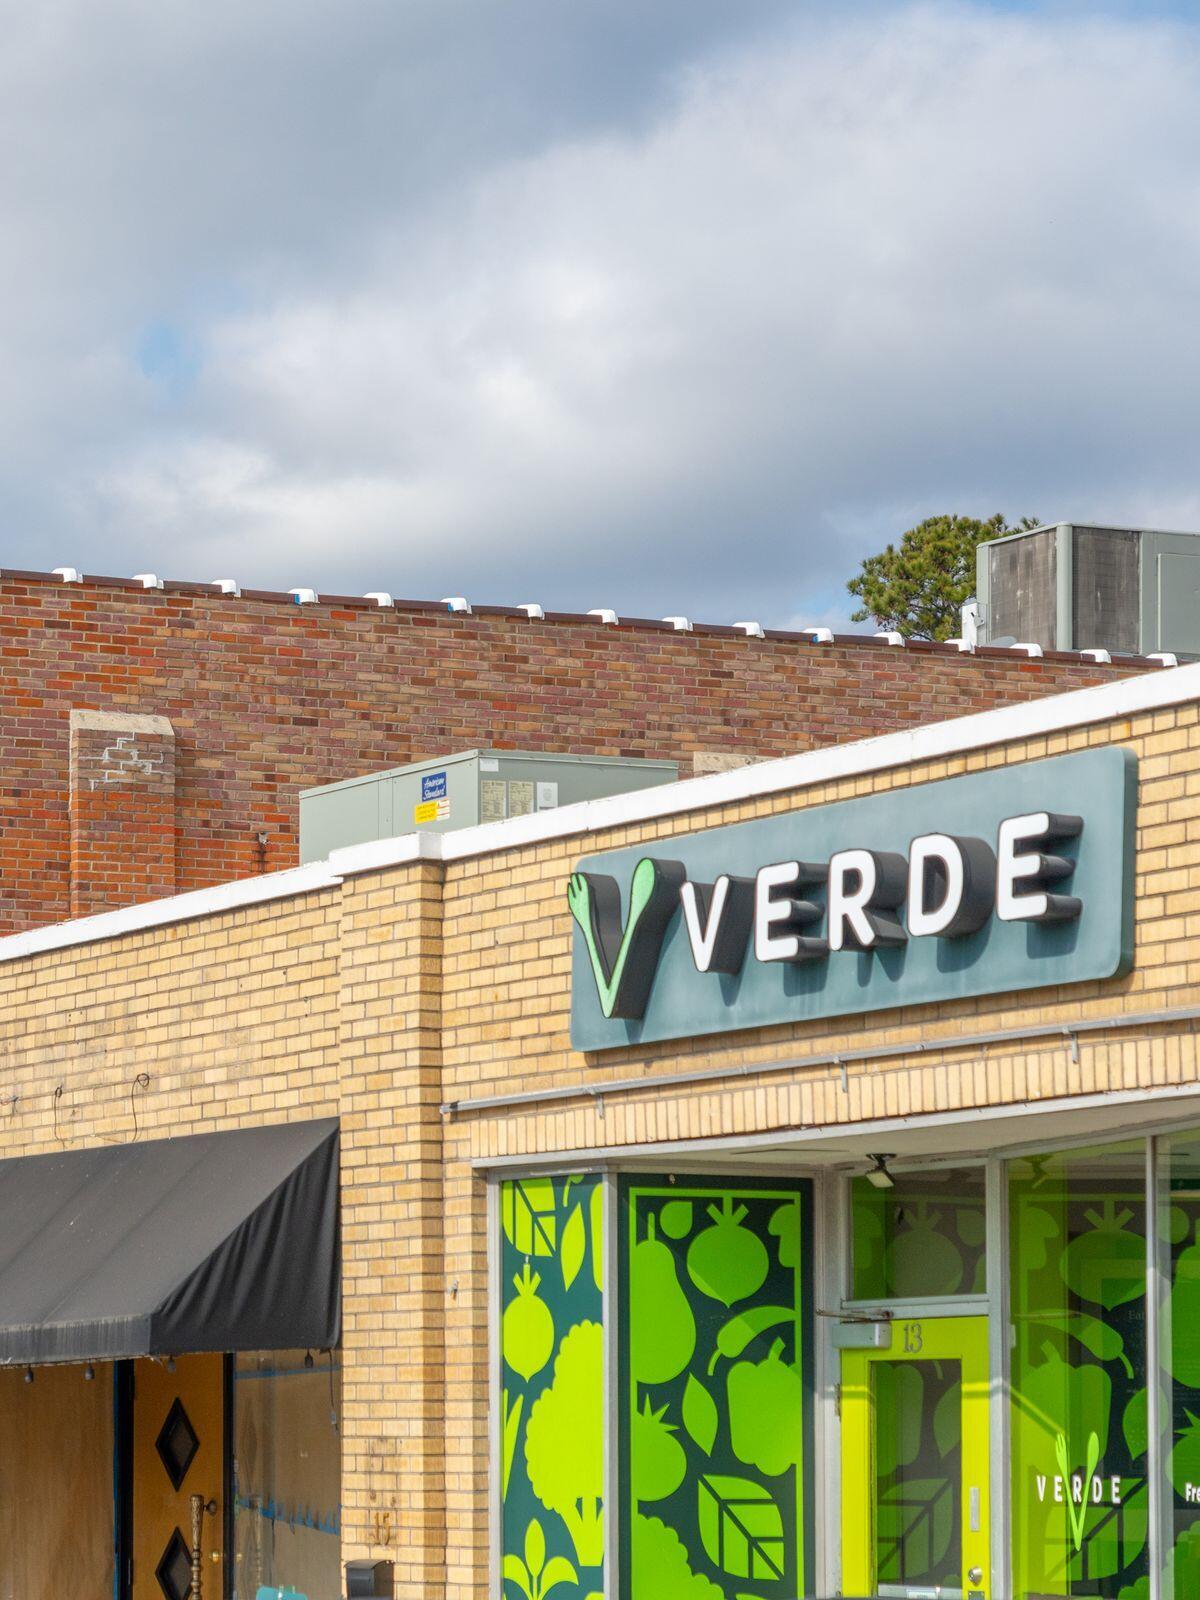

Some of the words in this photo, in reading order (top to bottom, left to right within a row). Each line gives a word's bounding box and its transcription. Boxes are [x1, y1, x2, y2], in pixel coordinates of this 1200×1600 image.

[679, 811, 1062, 974] VERDE
[903, 1323, 923, 1354] 13
[1036, 1475, 1121, 1504] VERDE
